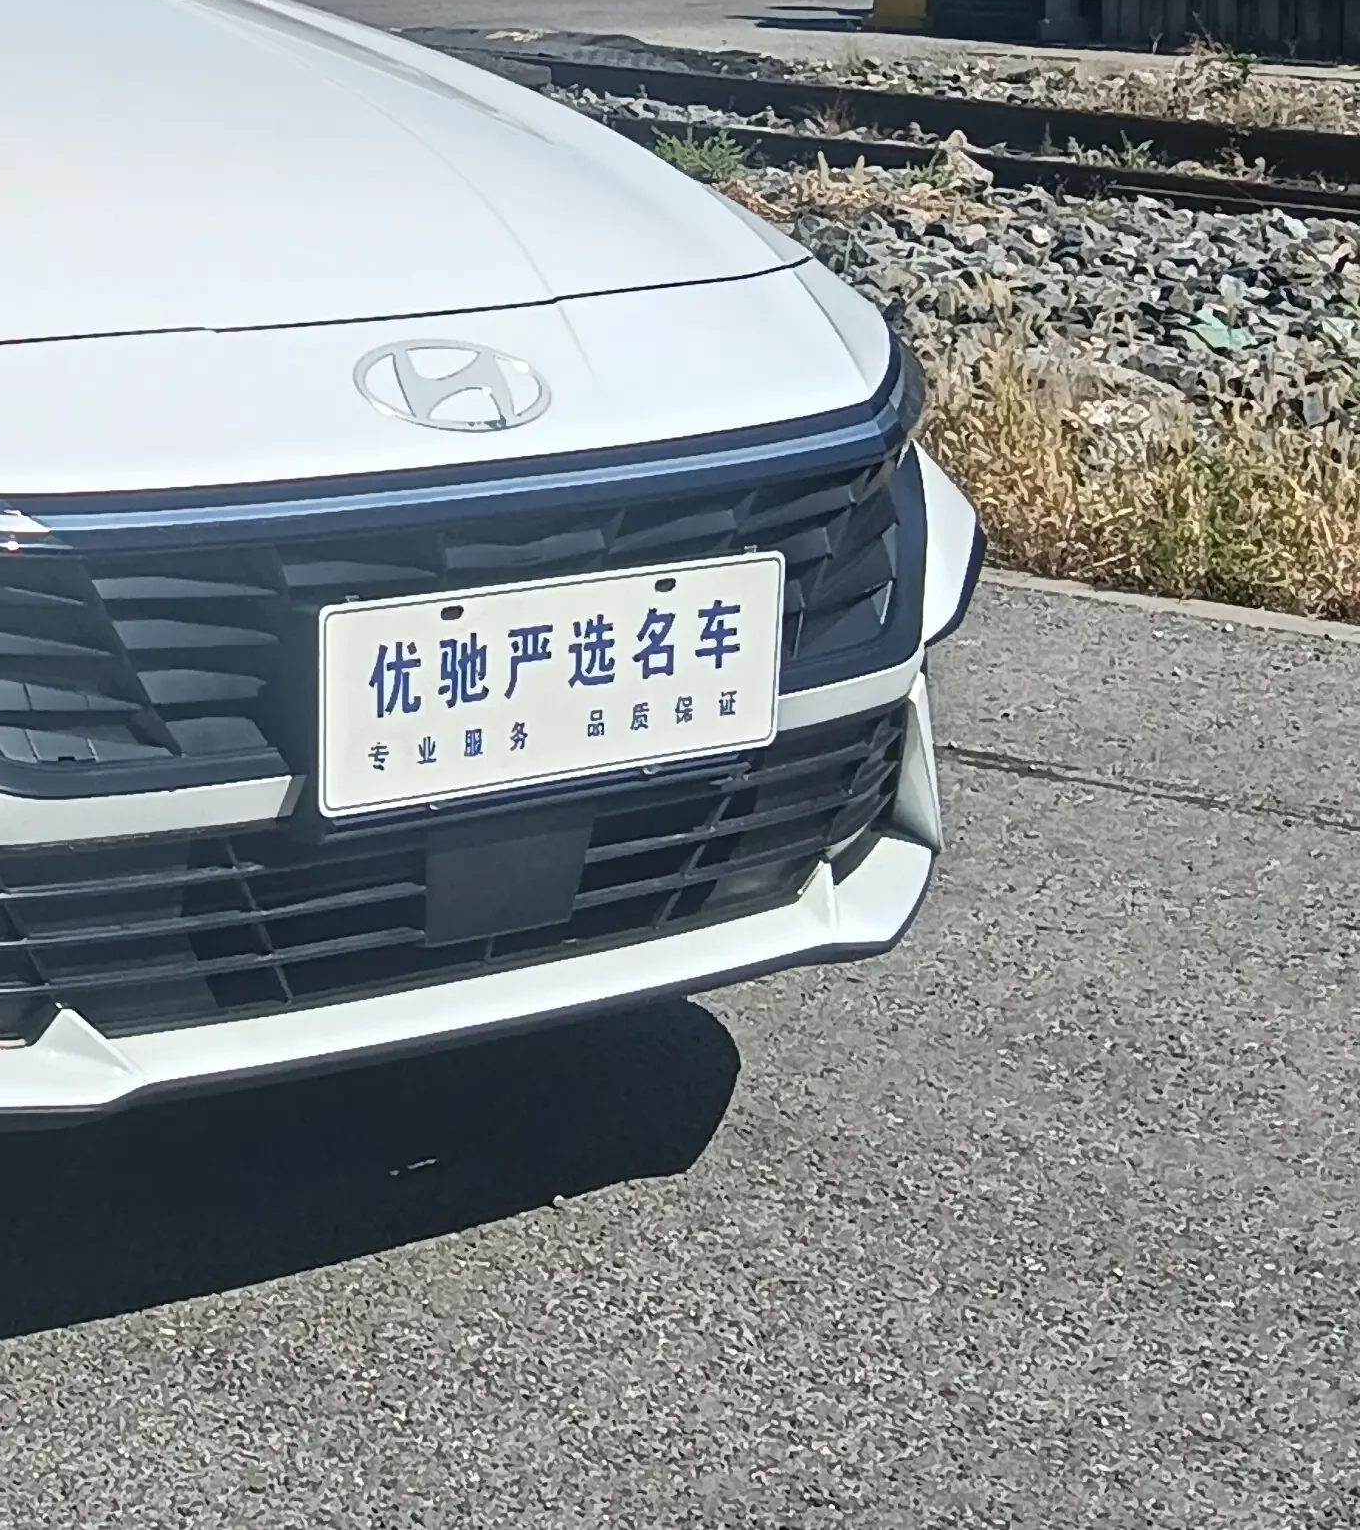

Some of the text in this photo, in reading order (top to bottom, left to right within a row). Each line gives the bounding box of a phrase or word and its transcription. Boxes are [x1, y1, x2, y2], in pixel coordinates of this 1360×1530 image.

[369, 599, 741, 719] 优驰严选名车
[368, 690, 738, 771] 专业服务 品质保证
